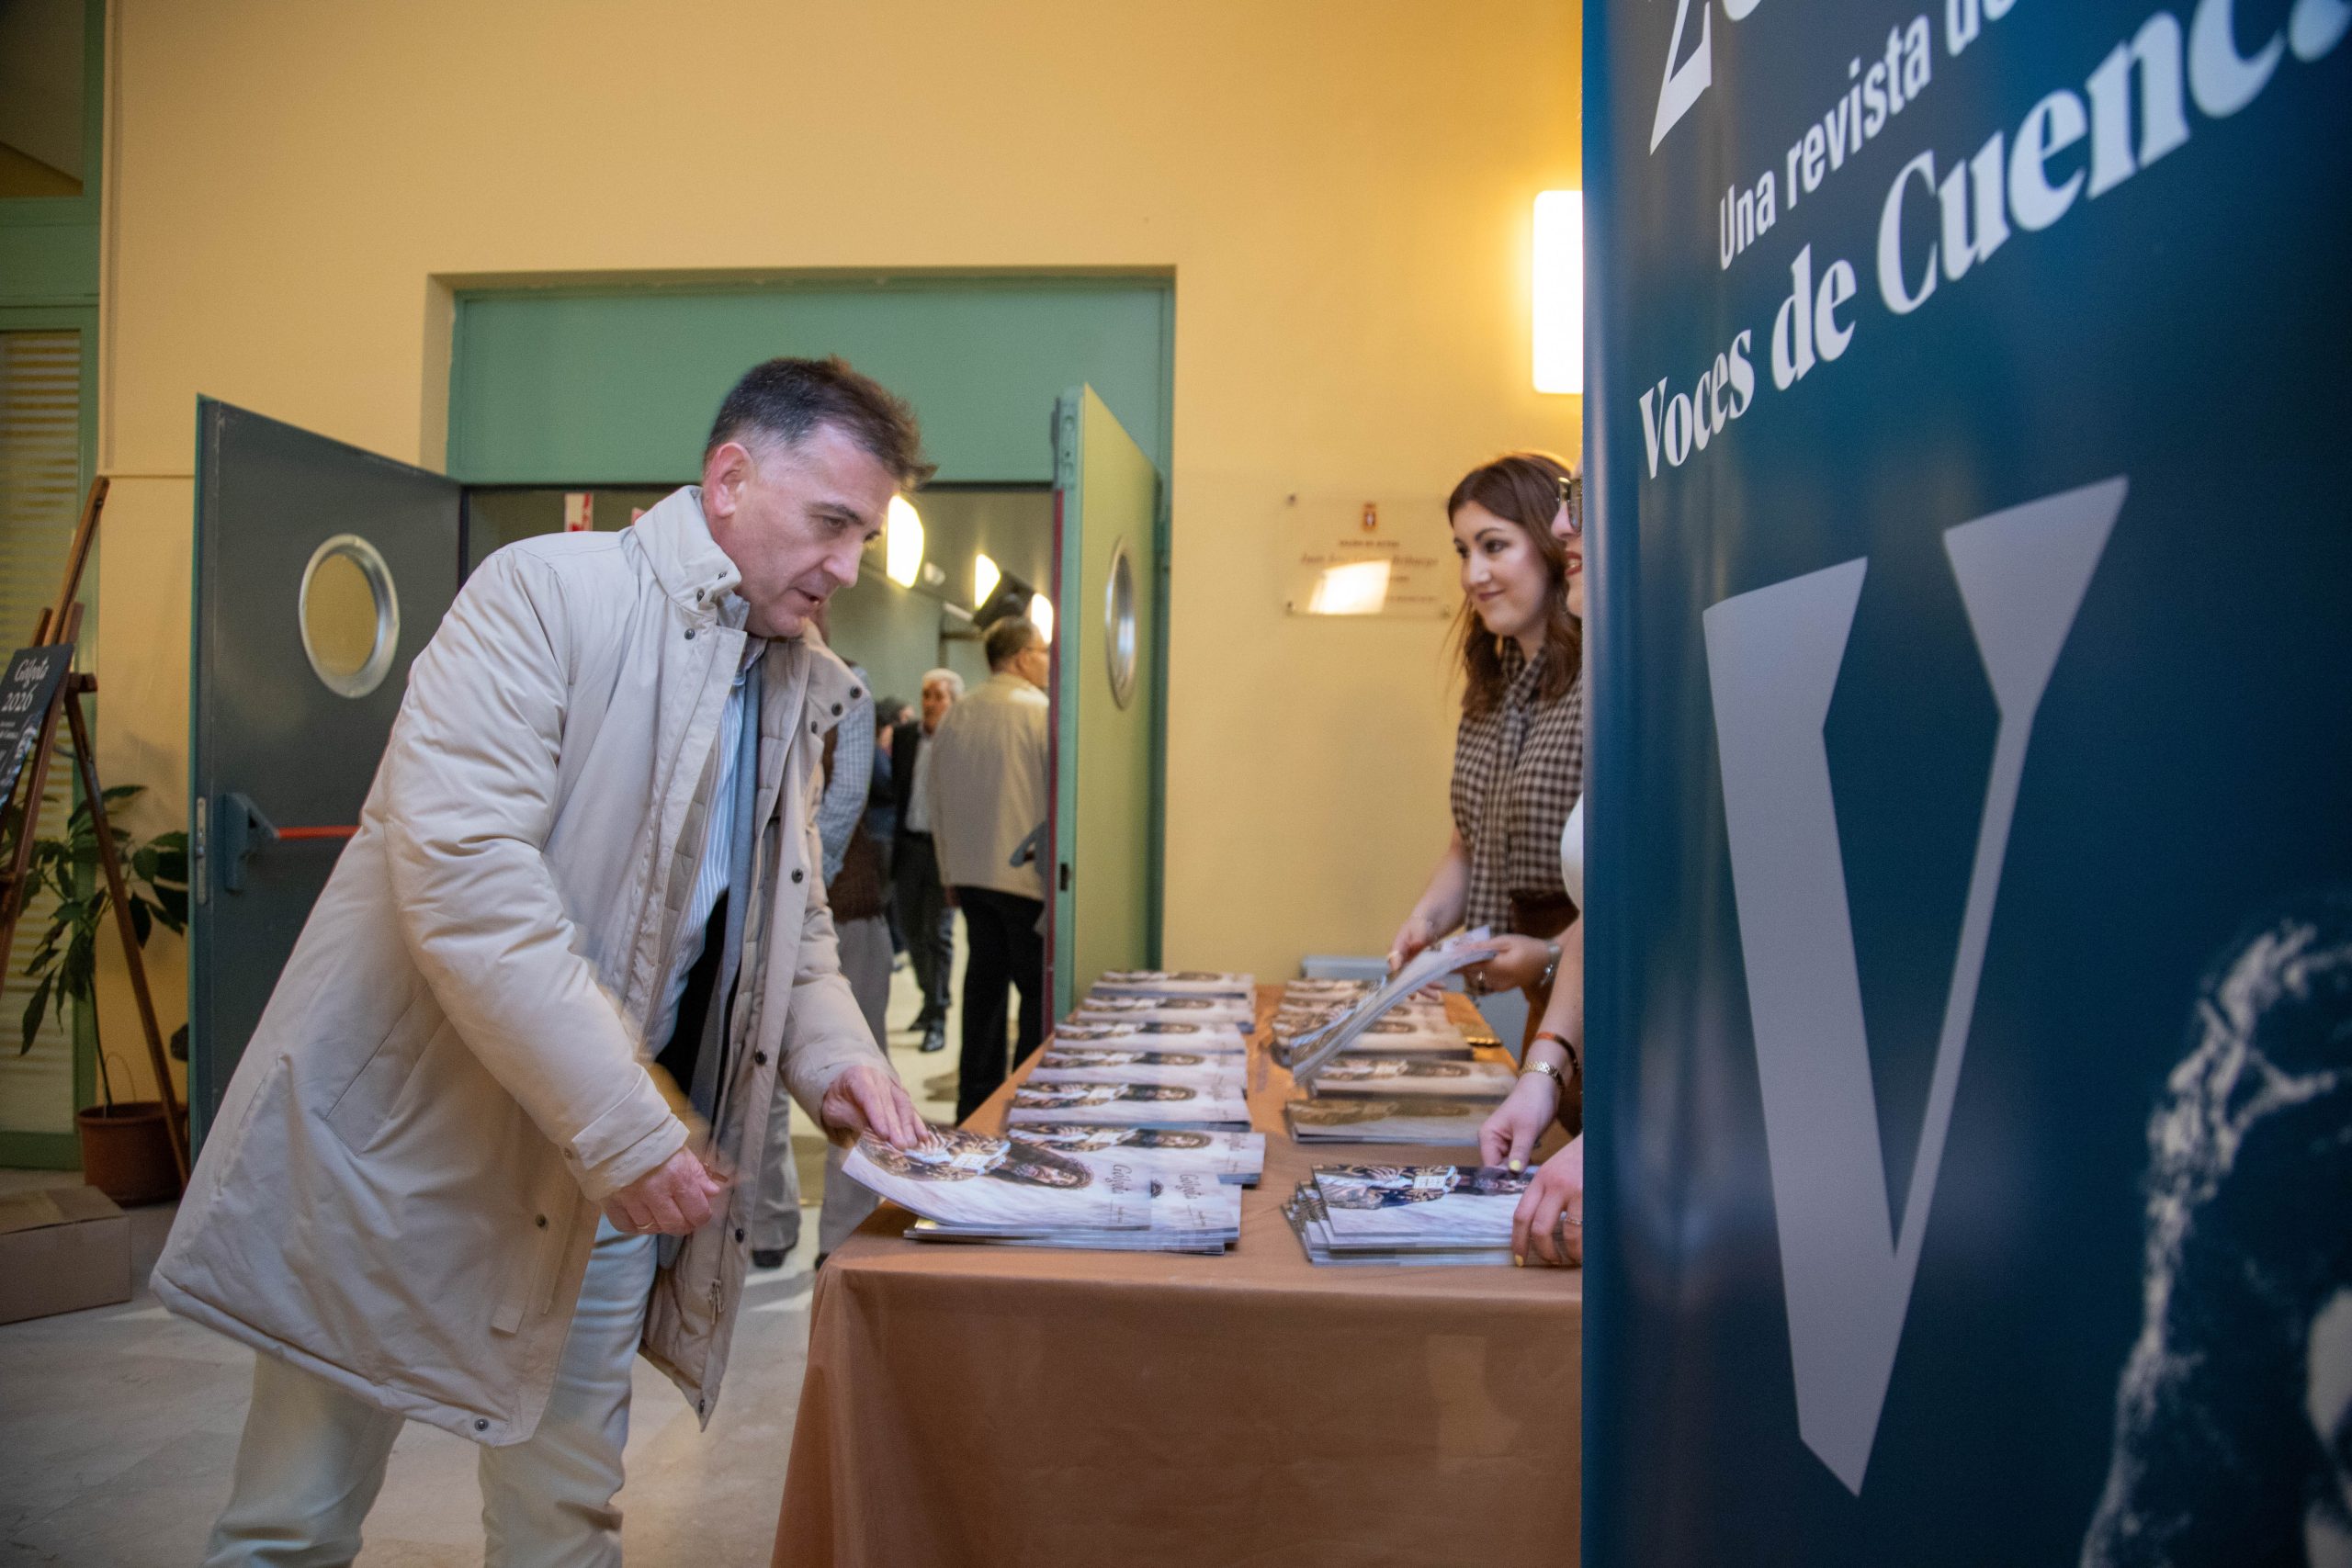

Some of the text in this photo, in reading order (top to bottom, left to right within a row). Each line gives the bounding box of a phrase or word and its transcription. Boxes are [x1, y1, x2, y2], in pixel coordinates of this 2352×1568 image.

[1719, 170, 1776, 271] Una
[1786, 14, 1931, 211] revista
[1638, 329, 1756, 479] Voces
[1771, 243, 1857, 390] de
[1, 683, 39, 712] 2026
[1702, 476, 2129, 1497] V
